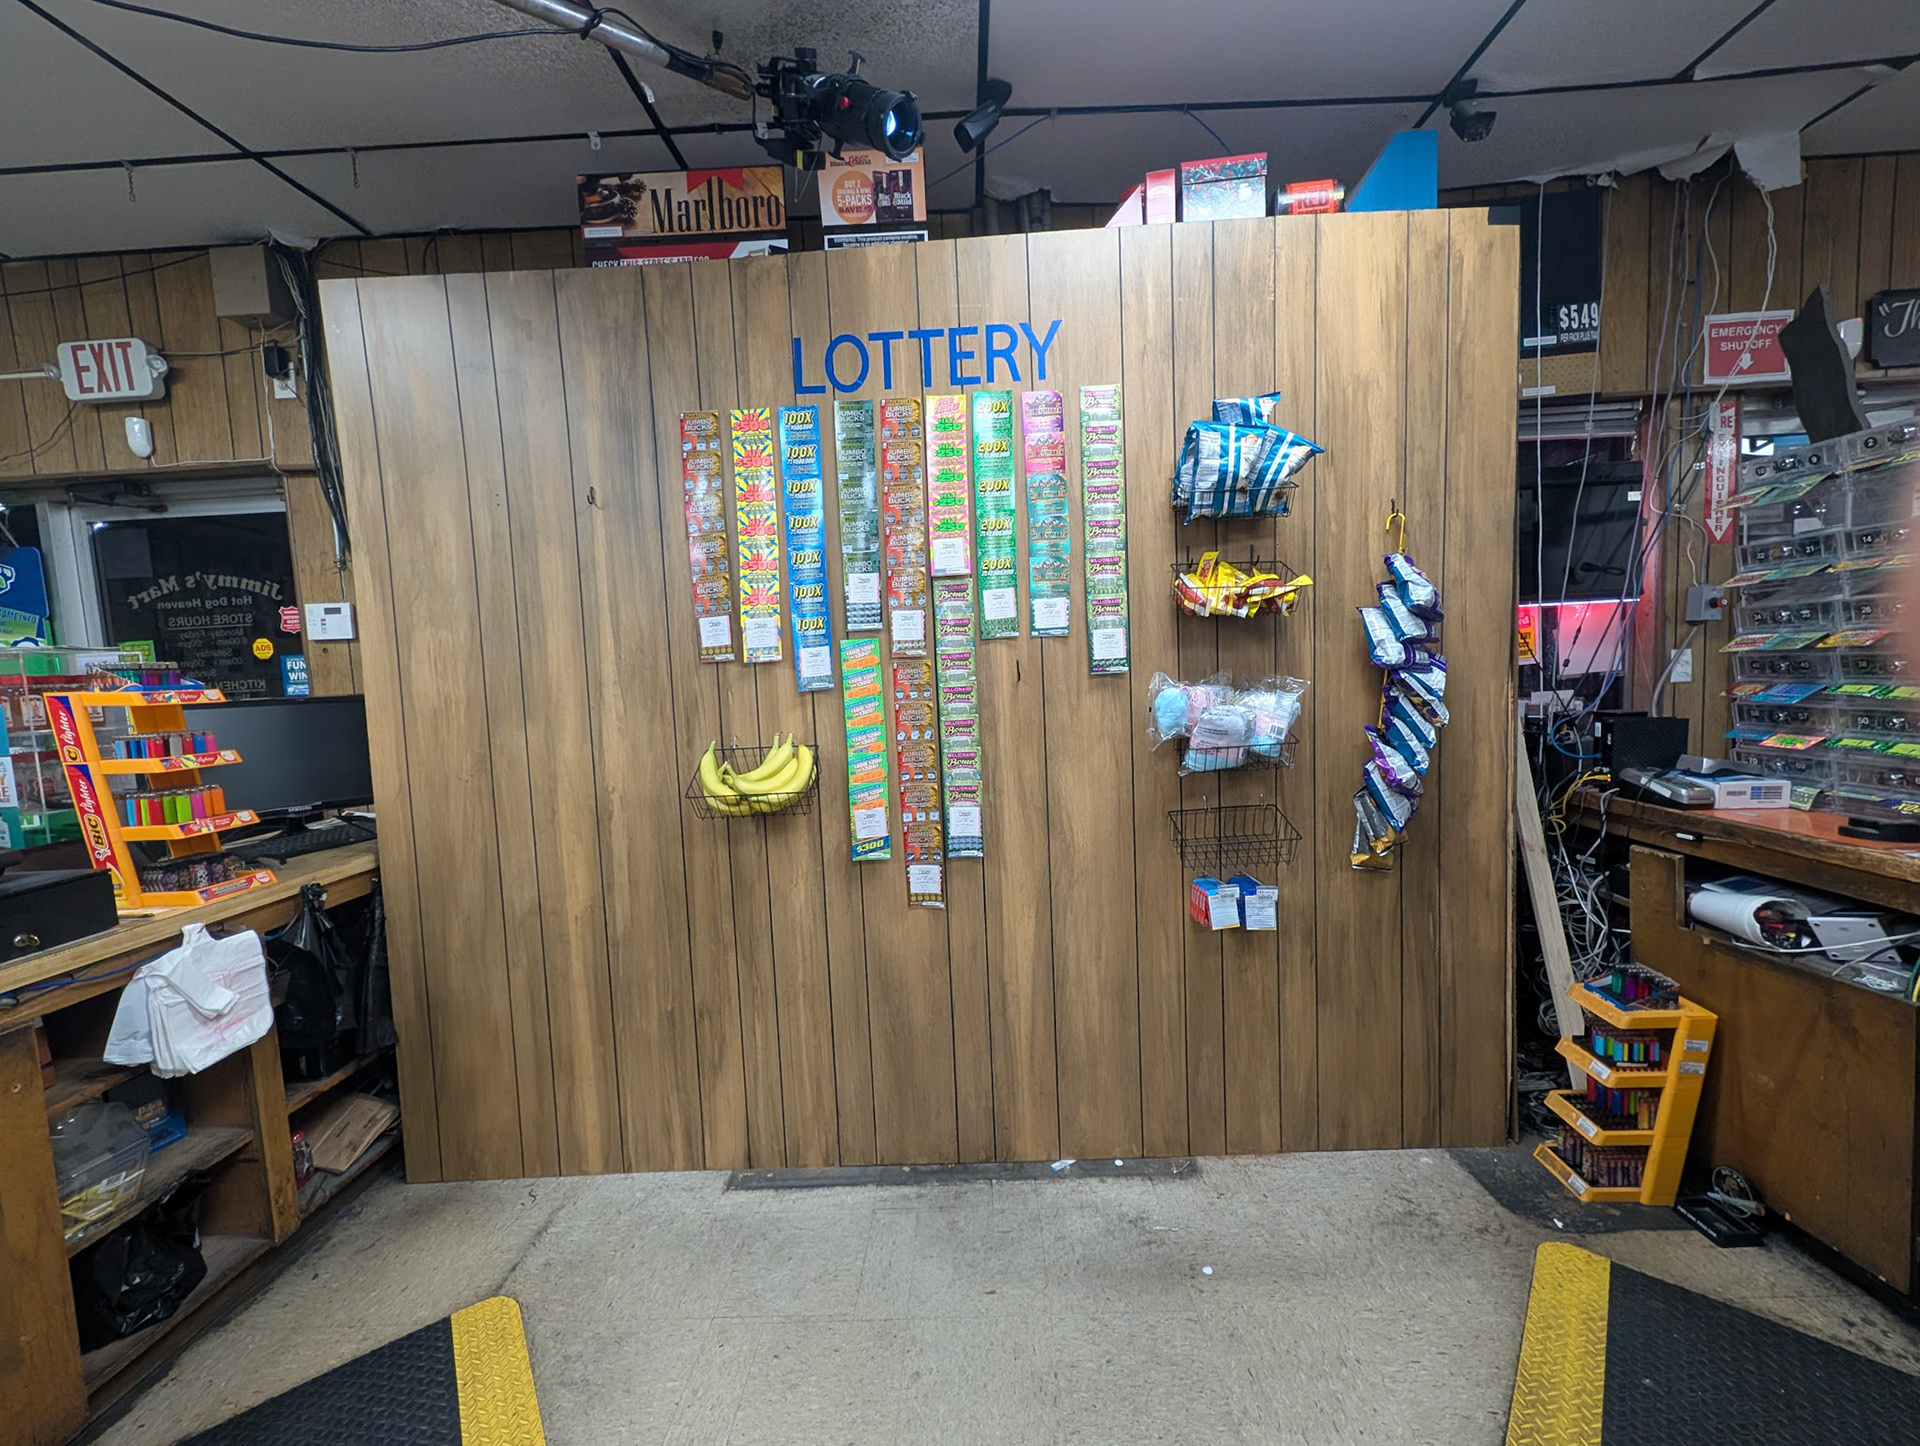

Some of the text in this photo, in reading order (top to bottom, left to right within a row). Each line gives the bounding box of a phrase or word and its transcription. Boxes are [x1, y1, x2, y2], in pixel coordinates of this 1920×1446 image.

[844, 180, 856, 188] BUY
[837, 194, 872, 206] 5-PACKS
[1297, 189, 1329, 208] RED
[649, 176, 782, 233] Marlboro
[1560, 302, 1599, 330] $5.49
[1711, 324, 1782, 338] EMERGENCY
[1720, 339, 1772, 351] SHUTOFF
[793, 320, 1062, 395] LOTTERY
[70, 341, 135, 394] EXIT
[742, 413, 759, 421] HIT
[784, 411, 813, 424] 100X
[733, 420, 769, 431] $500
[1086, 433, 1116, 441] Bonus
[786, 445, 815, 458] 100X
[978, 440, 1008, 452] 200X
[745, 449, 762, 457] HIT
[736, 456, 771, 467] $500
[1087, 468, 1117, 476] Bonus
[746, 484, 764, 492] HIT
[788, 480, 816, 492] 100X
[979, 479, 1009, 492] 200X
[738, 491, 774, 501] $500
[1088, 492, 1118, 501] Bonus
[748, 518, 765, 526] HIT
[790, 515, 817, 528] 100X
[981, 519, 1010, 531] 200X
[740, 525, 775, 536] $500
[1090, 527, 1120, 535] Bonus
[792, 550, 820, 564] 100X
[742, 560, 776, 570] $500
[983, 558, 1012, 570] 200X
[1090, 564, 1120, 572] Bonus
[751, 588, 768, 596] HIT
[794, 585, 822, 598] 100X
[743, 595, 777, 605] $500
[1091, 606, 1121, 614] Bonus
[18, 614, 37, 624] INFO
[797, 617, 824, 630] 100X
[255, 644, 272, 652] ADS
[286, 661, 306, 670] FUN
[941, 660, 970, 668] Bonus
[288, 672, 308, 680] WIN
[943, 693, 973, 701] Bonus
[60, 710, 75, 745] Lighter
[945, 727, 974, 735] Bonus
[947, 759, 977, 767] Bonus
[80, 779, 96, 813] Lighter
[949, 792, 978, 800] Bonus
[857, 839, 884, 852] $300
